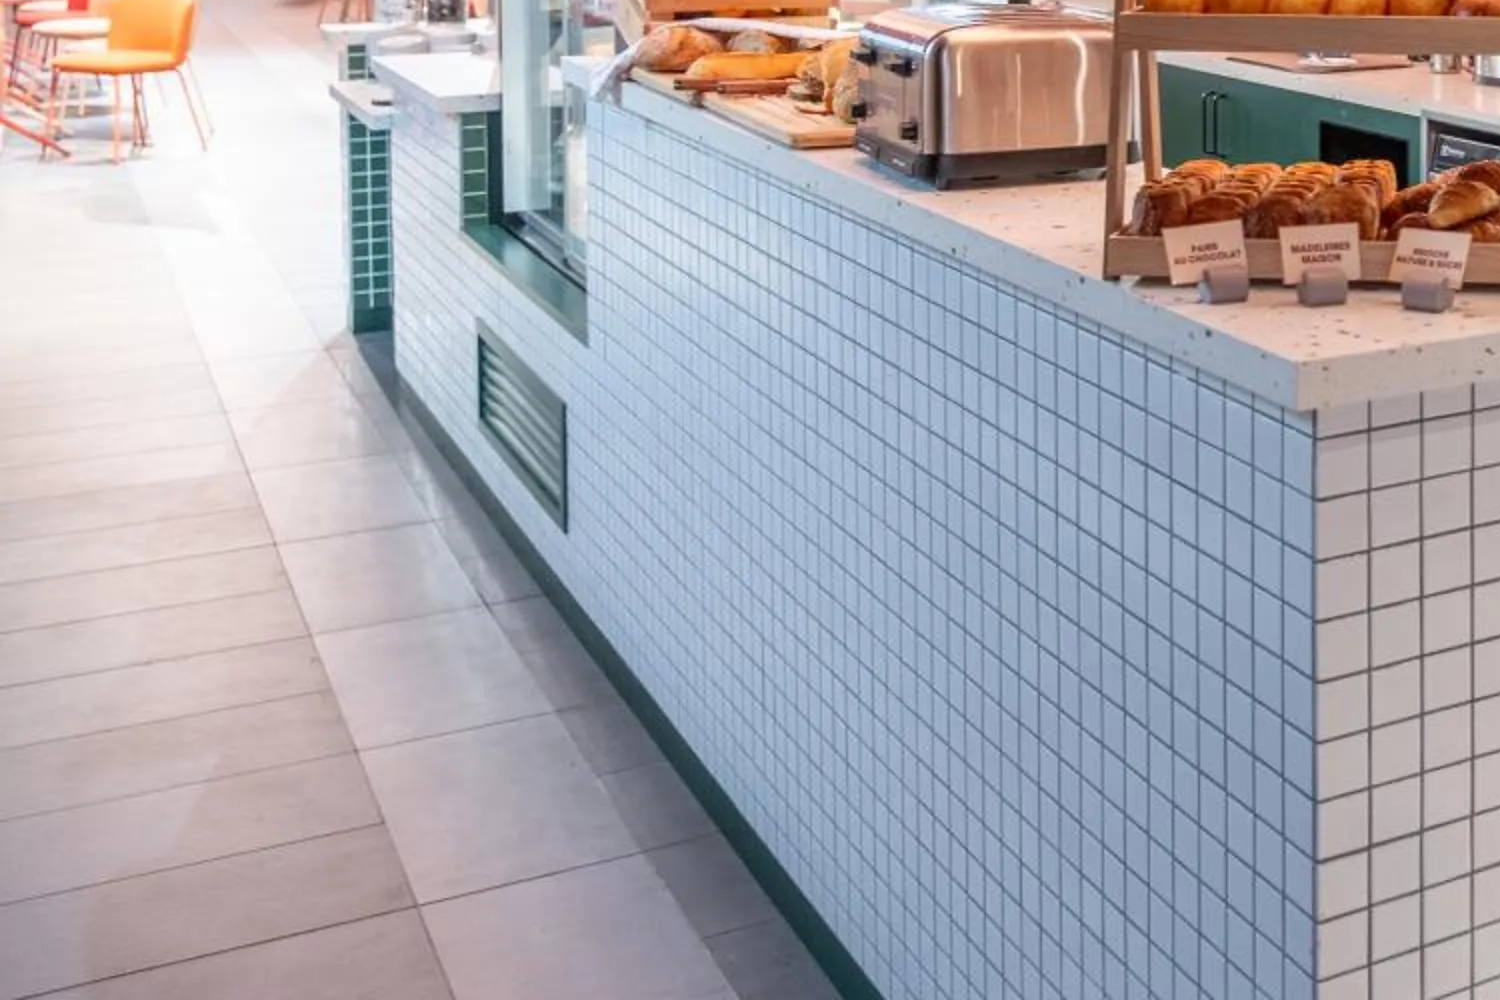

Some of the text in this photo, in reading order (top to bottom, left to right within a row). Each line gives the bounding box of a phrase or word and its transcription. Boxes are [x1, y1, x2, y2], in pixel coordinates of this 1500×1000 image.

[1290, 241, 1351, 254] MADELEINES
[1188, 248, 1241, 264] CHOCOLAT
[1301, 254, 1342, 264] MAISON
